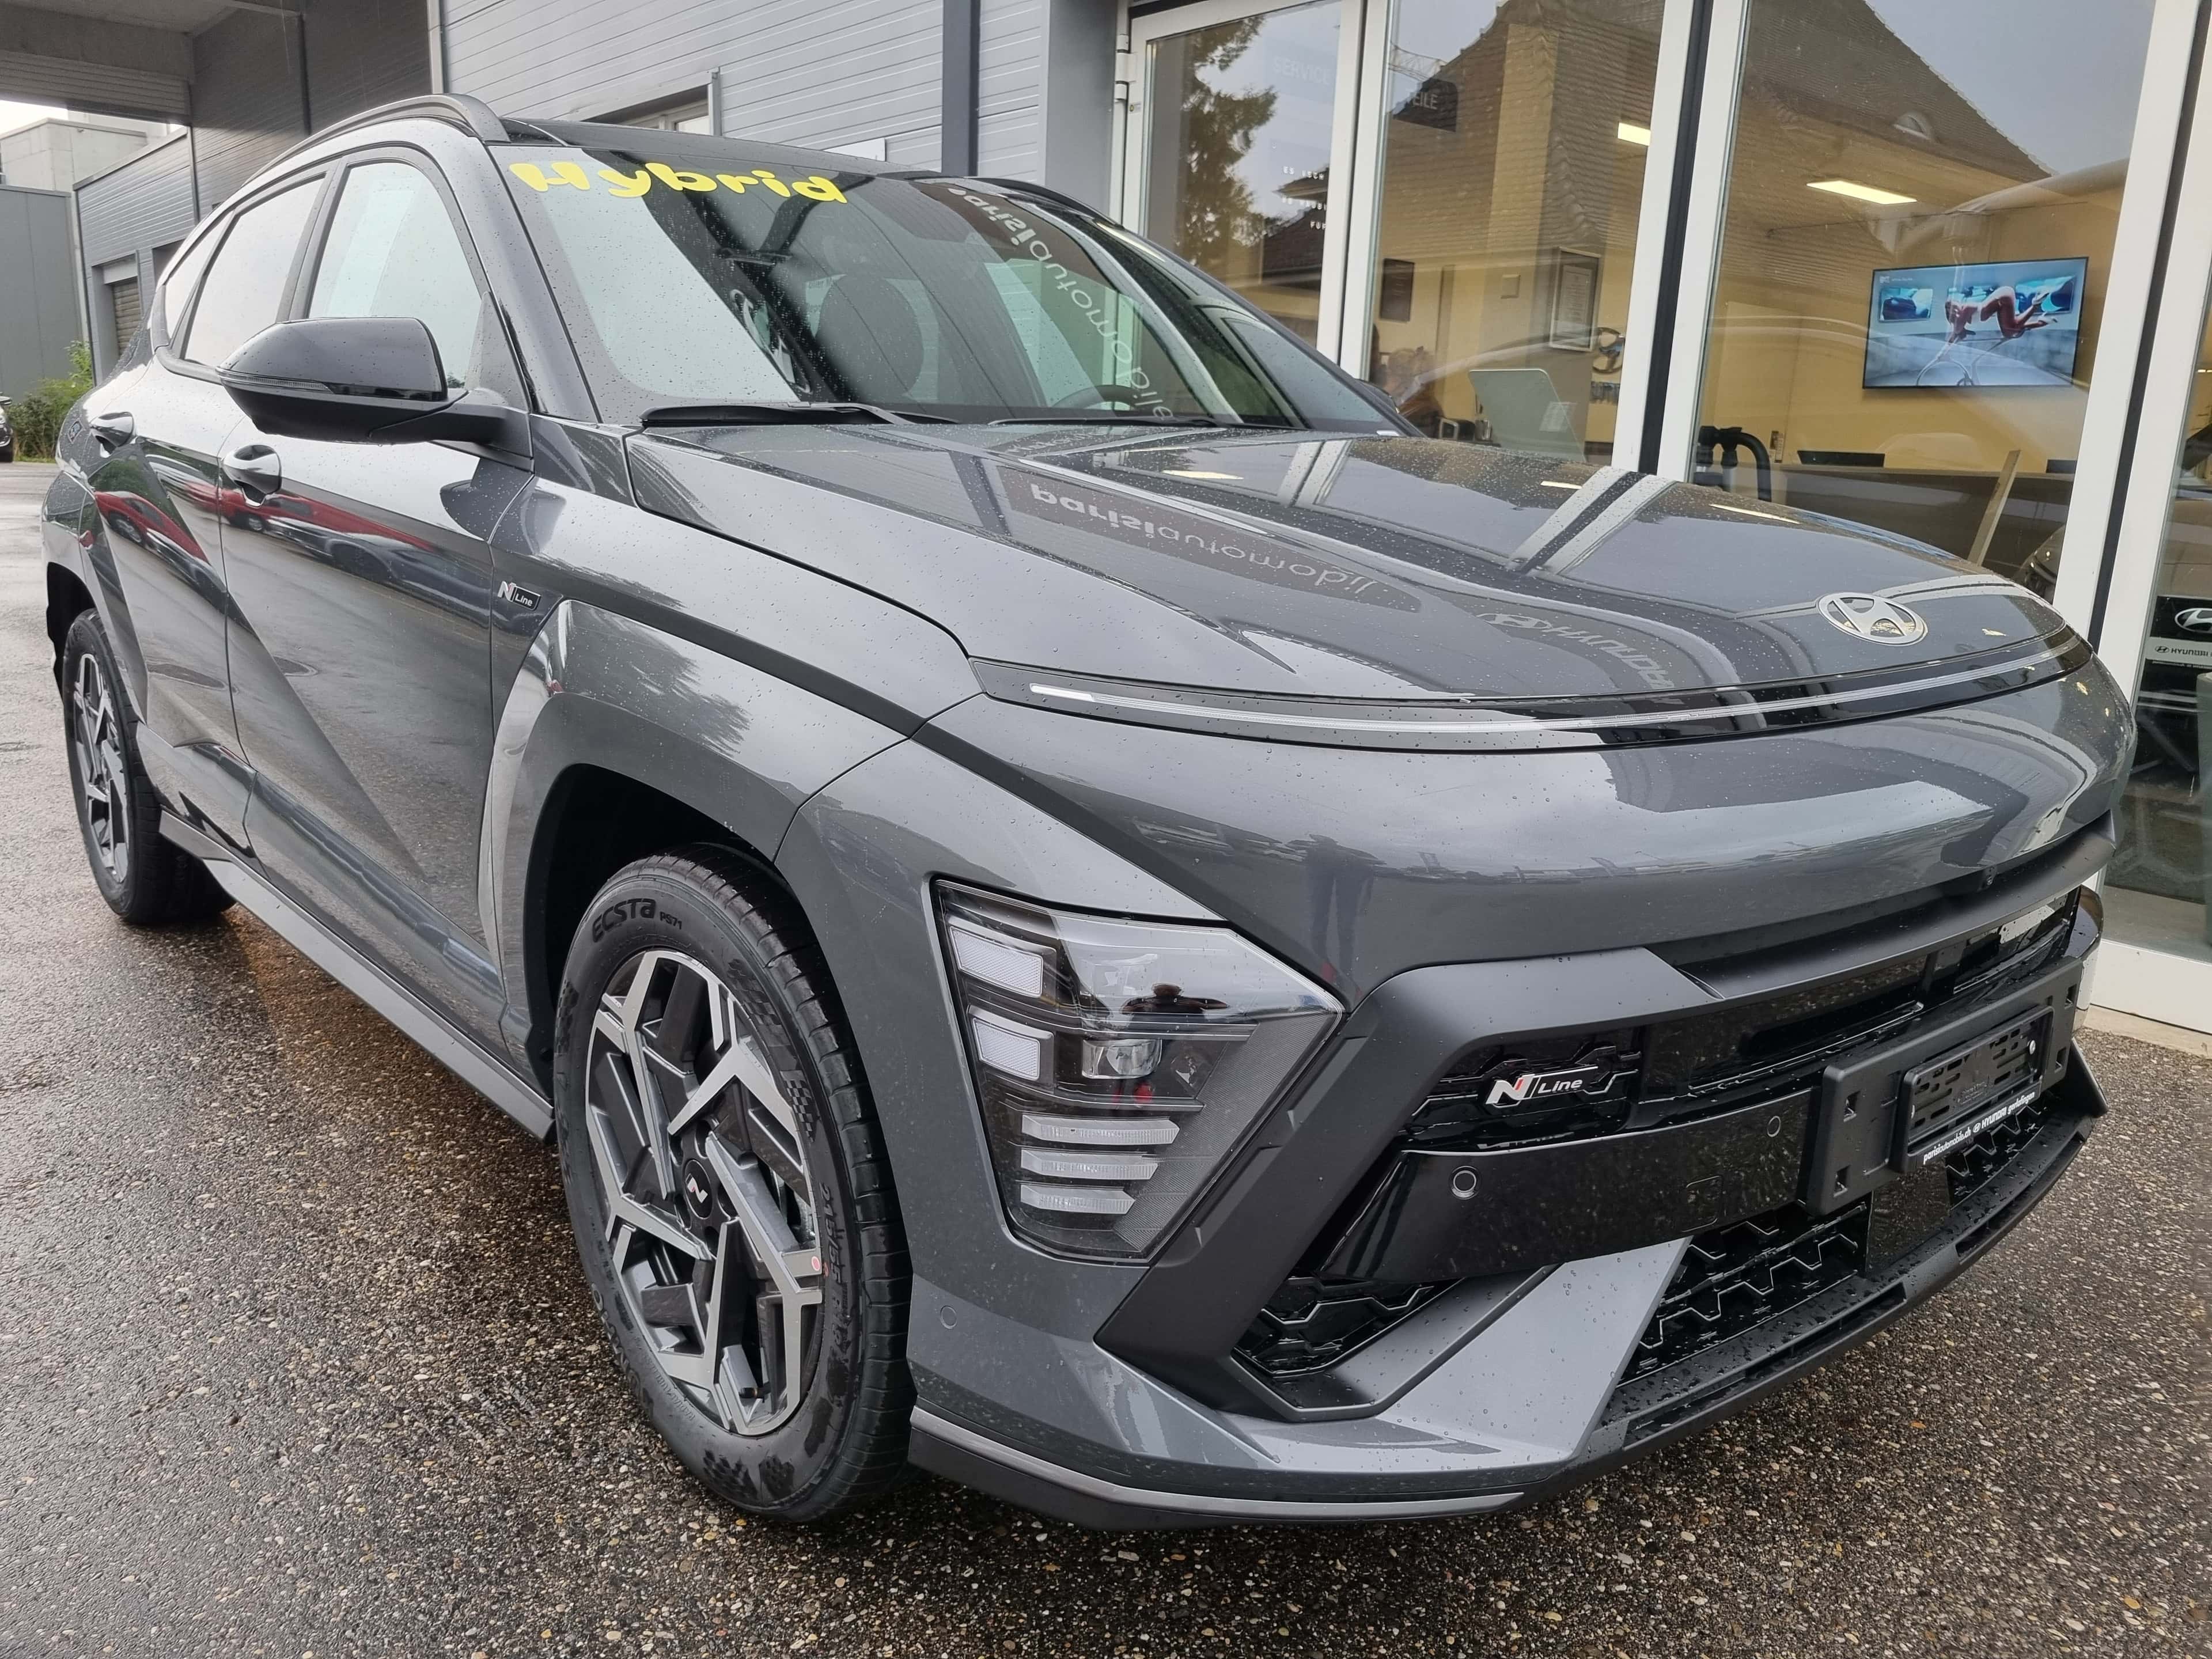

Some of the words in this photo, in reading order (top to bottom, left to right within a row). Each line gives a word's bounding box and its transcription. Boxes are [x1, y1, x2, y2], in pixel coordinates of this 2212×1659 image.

[509, 162, 847, 203] Hybrid
[514, 593, 533, 607] Line
[660, 911, 683, 930] PS71
[1537, 1080, 1583, 1094] Line
